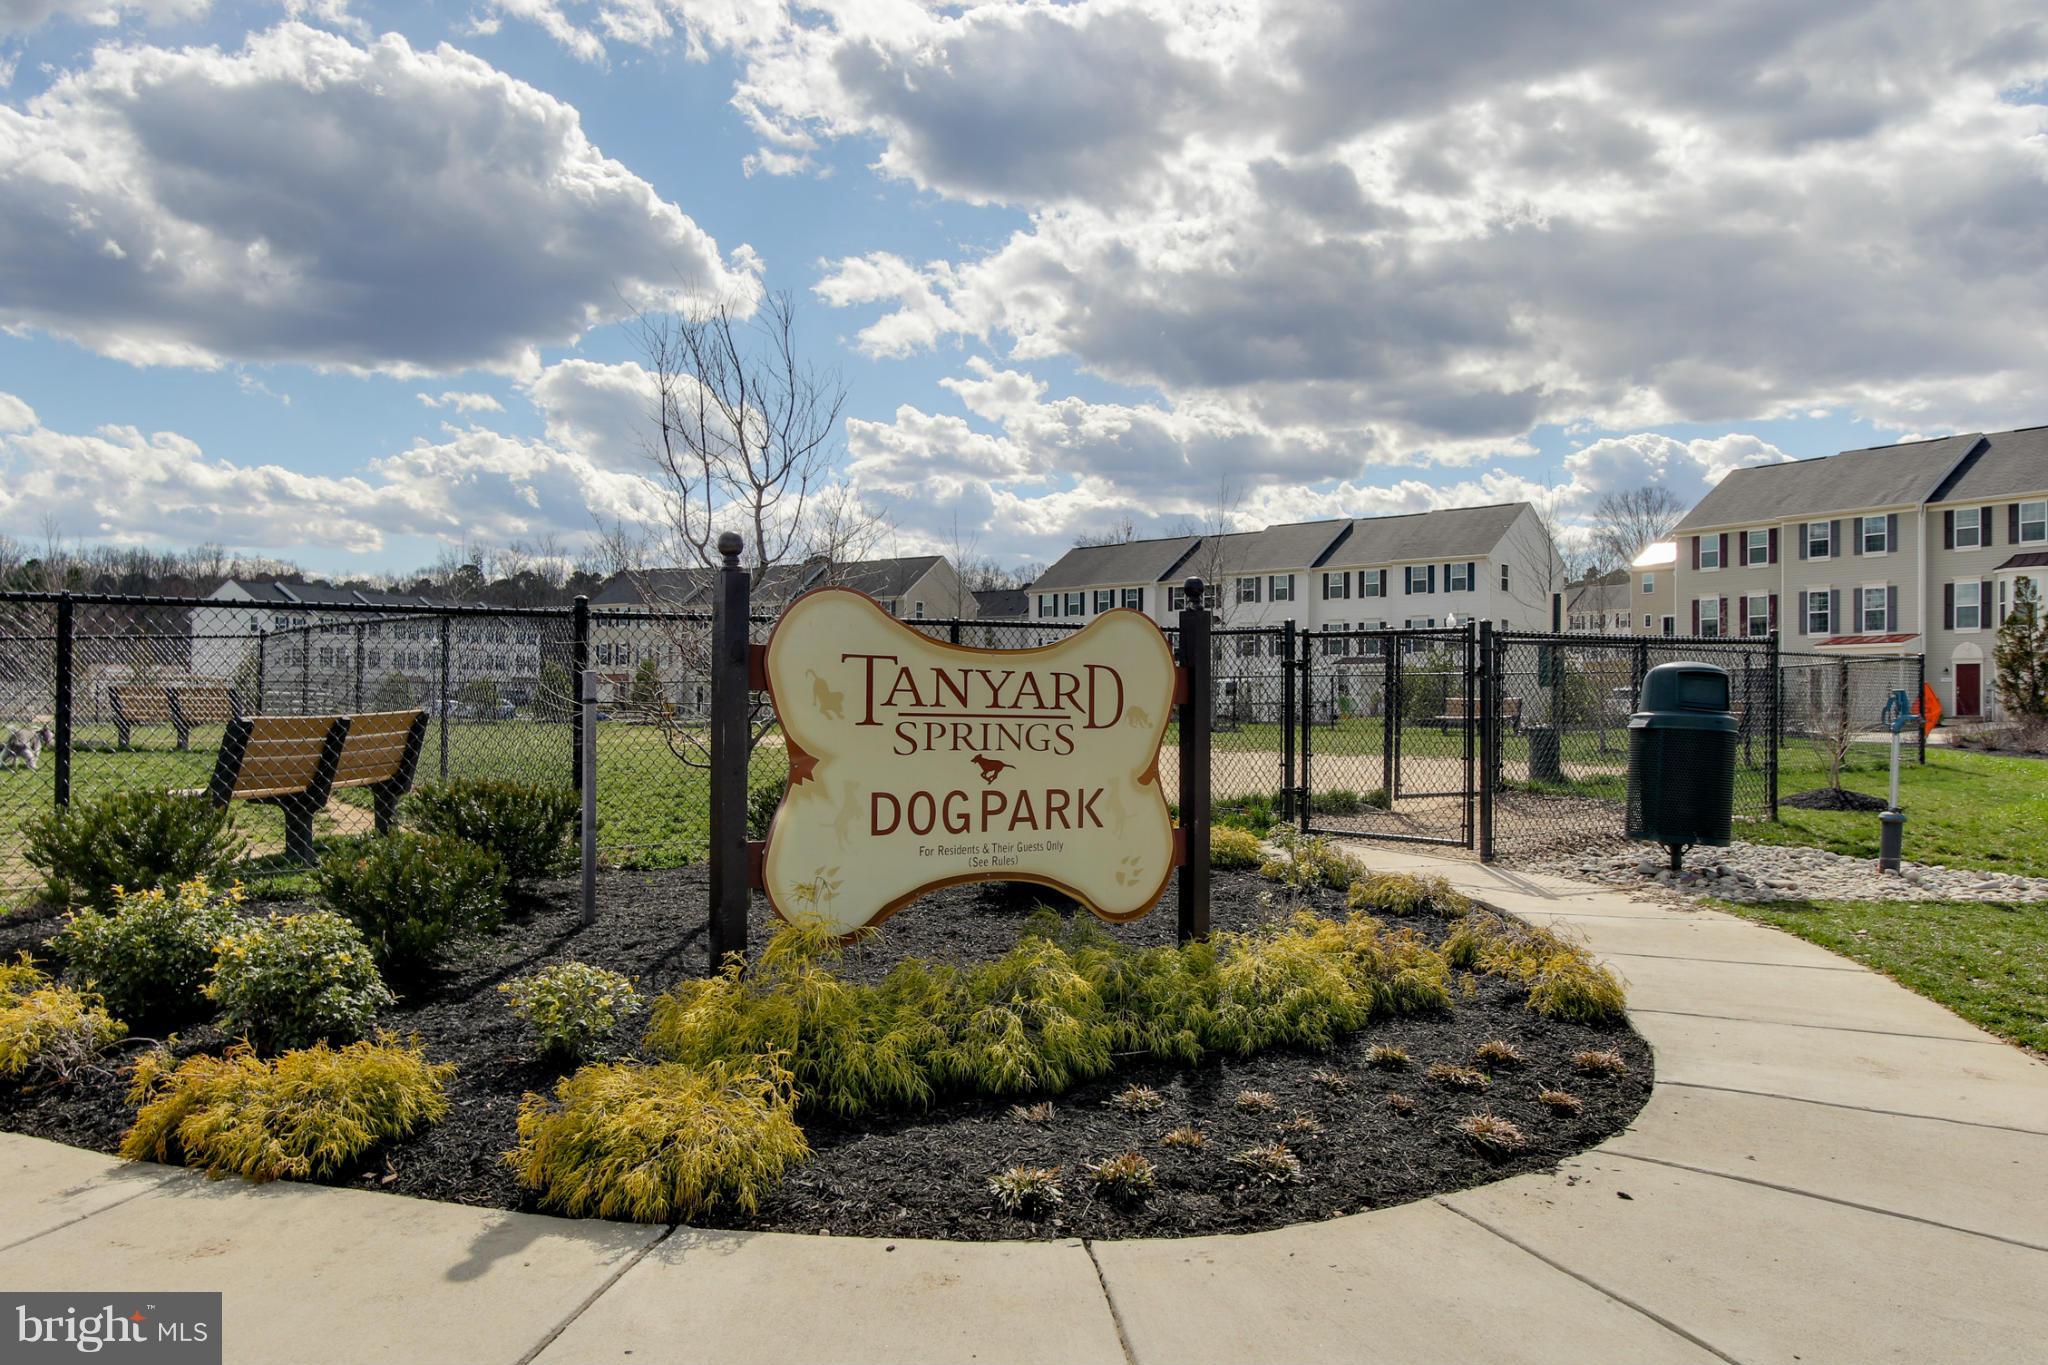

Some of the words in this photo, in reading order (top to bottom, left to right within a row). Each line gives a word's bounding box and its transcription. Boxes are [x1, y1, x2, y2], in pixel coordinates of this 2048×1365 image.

[841, 653, 1124, 729] TANYARD
[893, 721, 1075, 756] SPRINGS
[919, 846, 935, 857] For
[937, 844, 980, 856] Residents
[982, 842, 990, 854] &
[991, 842, 1014, 853] Their
[1016, 841, 1044, 853] Guests
[1046, 840, 1064, 852] Only
[968, 857, 989, 867] (See
[991, 855, 1019, 866] Rules)
